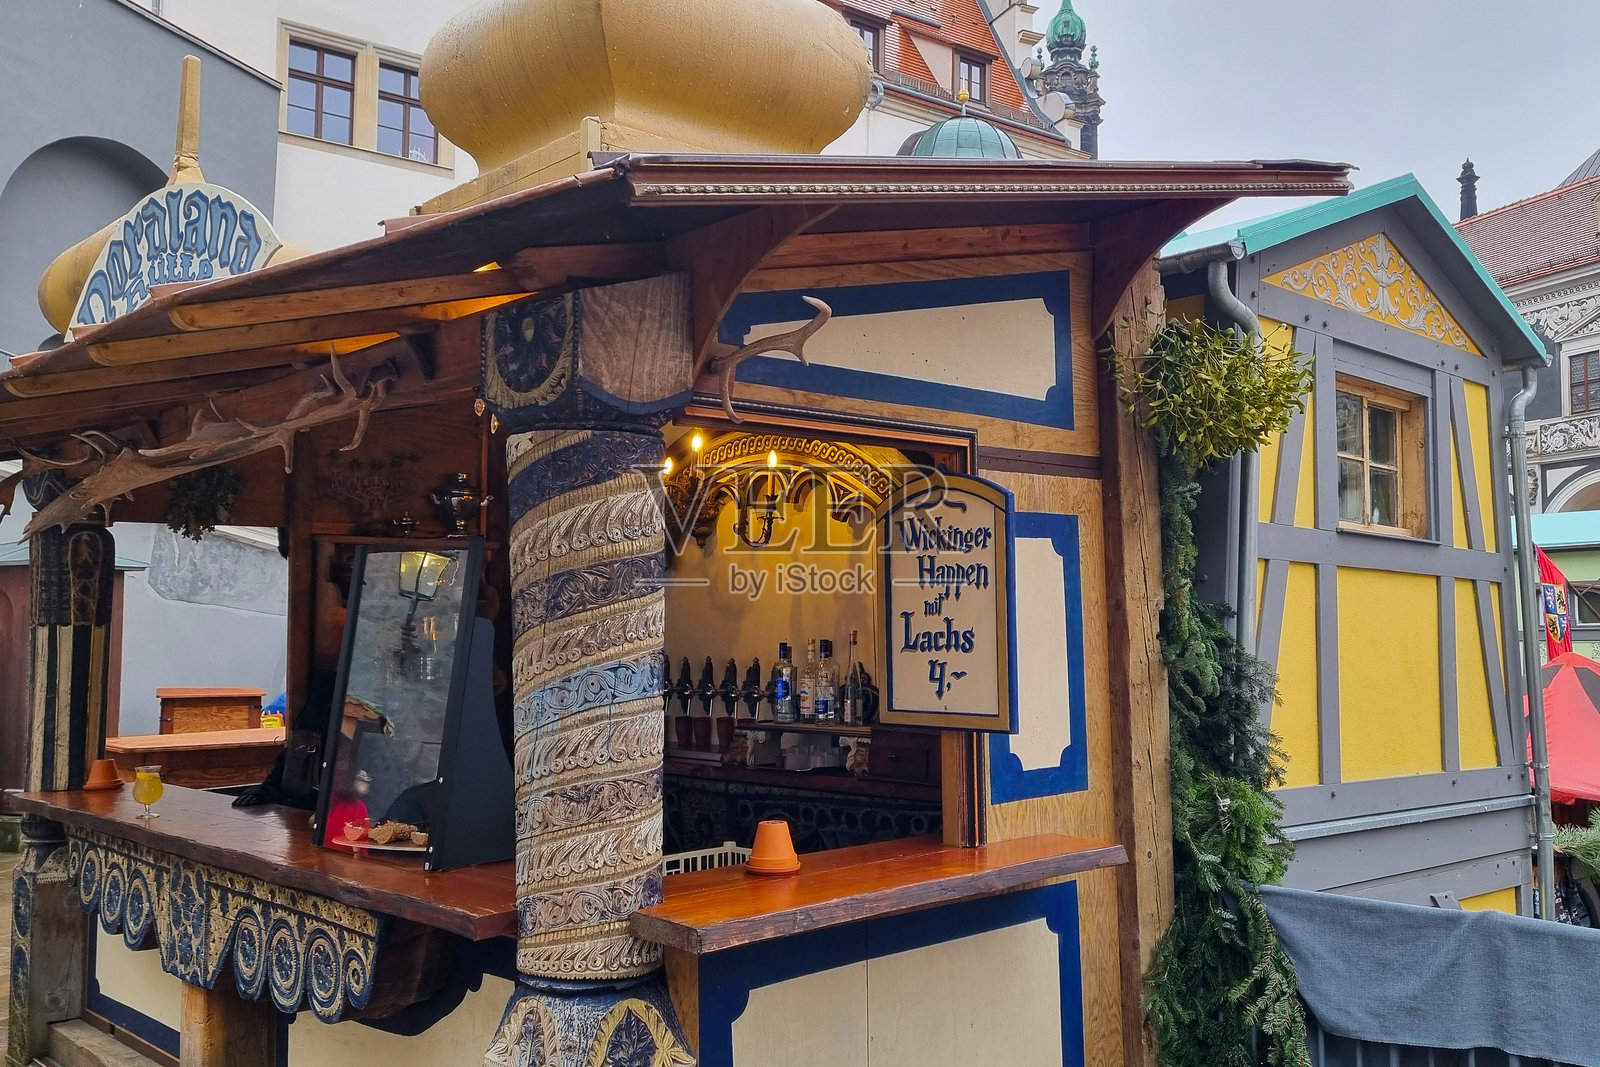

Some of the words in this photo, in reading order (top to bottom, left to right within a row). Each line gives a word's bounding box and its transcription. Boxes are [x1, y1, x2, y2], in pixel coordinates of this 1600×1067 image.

[895, 516, 992, 554] Wickinger
[916, 555, 989, 602] Happen
[924, 593, 945, 617] mit
[900, 611, 976, 654] Lachs
